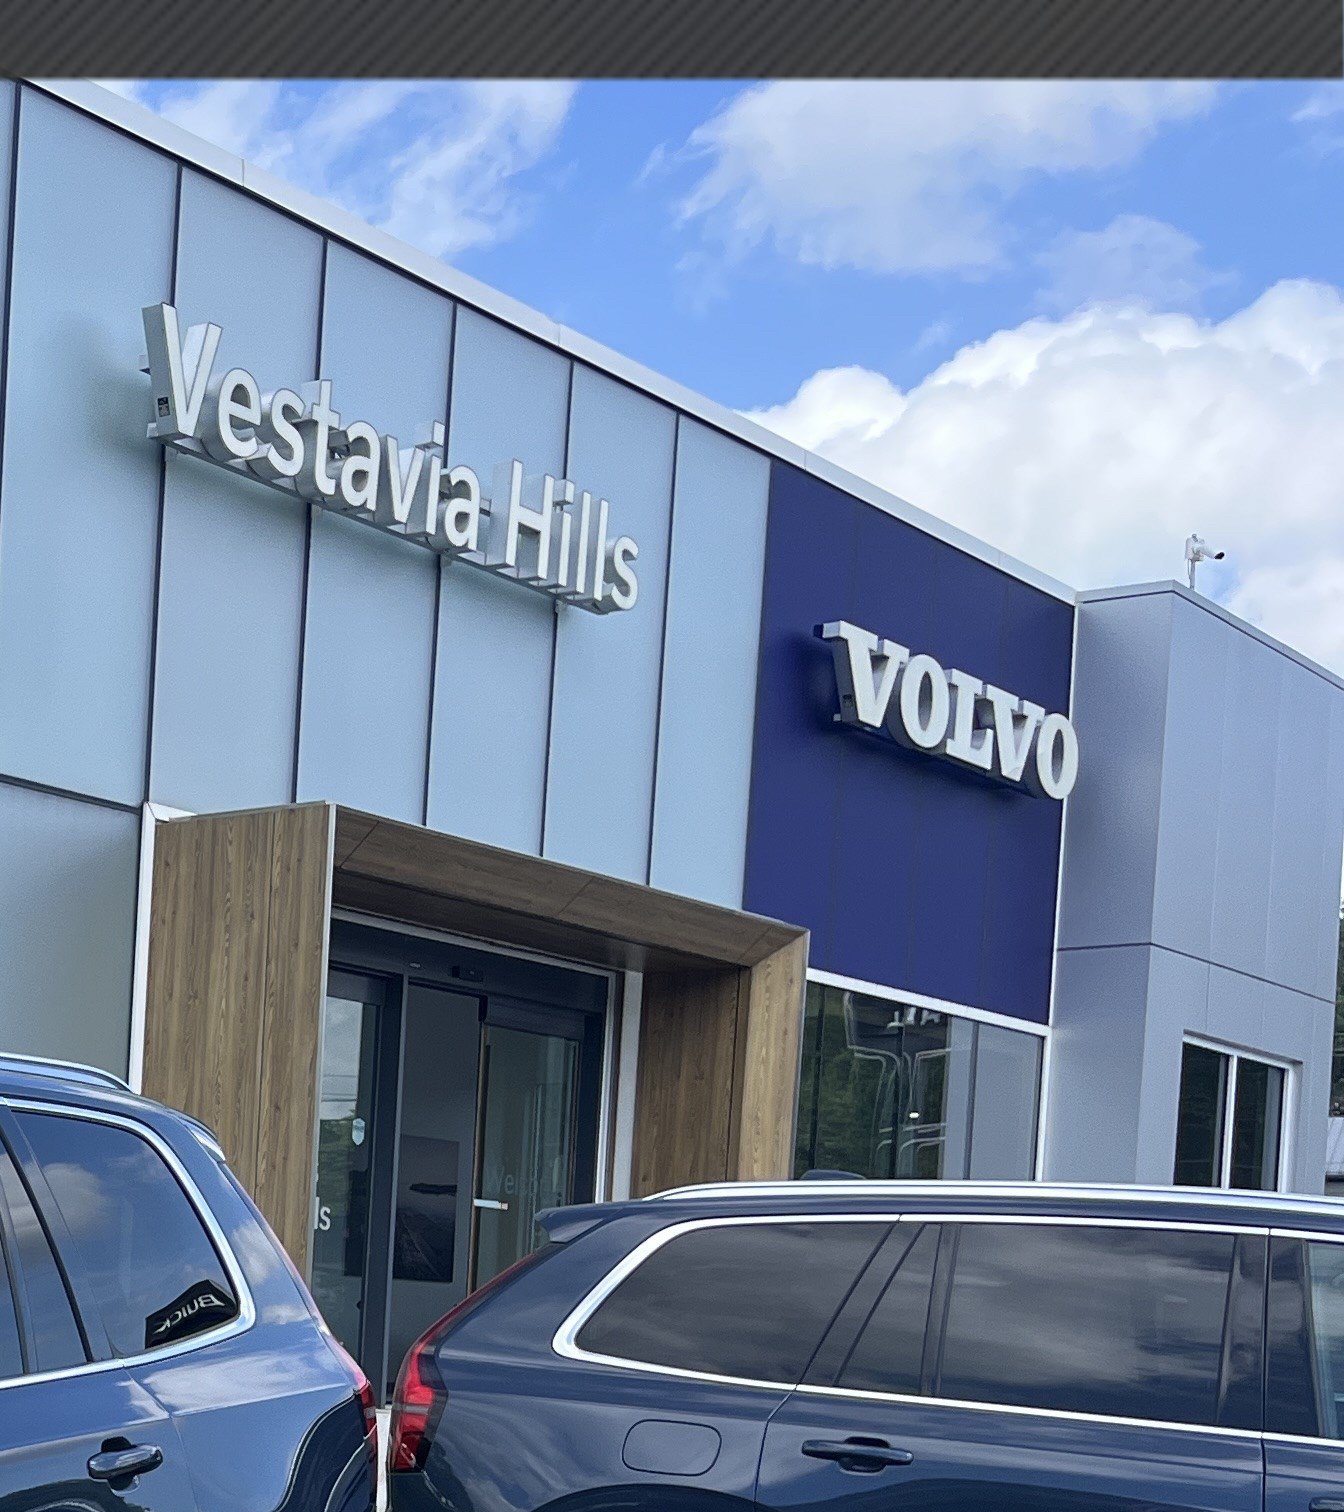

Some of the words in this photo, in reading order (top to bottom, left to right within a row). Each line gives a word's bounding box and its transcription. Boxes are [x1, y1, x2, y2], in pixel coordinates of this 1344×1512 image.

[144, 303, 481, 551] Vestavia
[502, 459, 639, 611] Hills
[823, 620, 1079, 800] VOLVO
